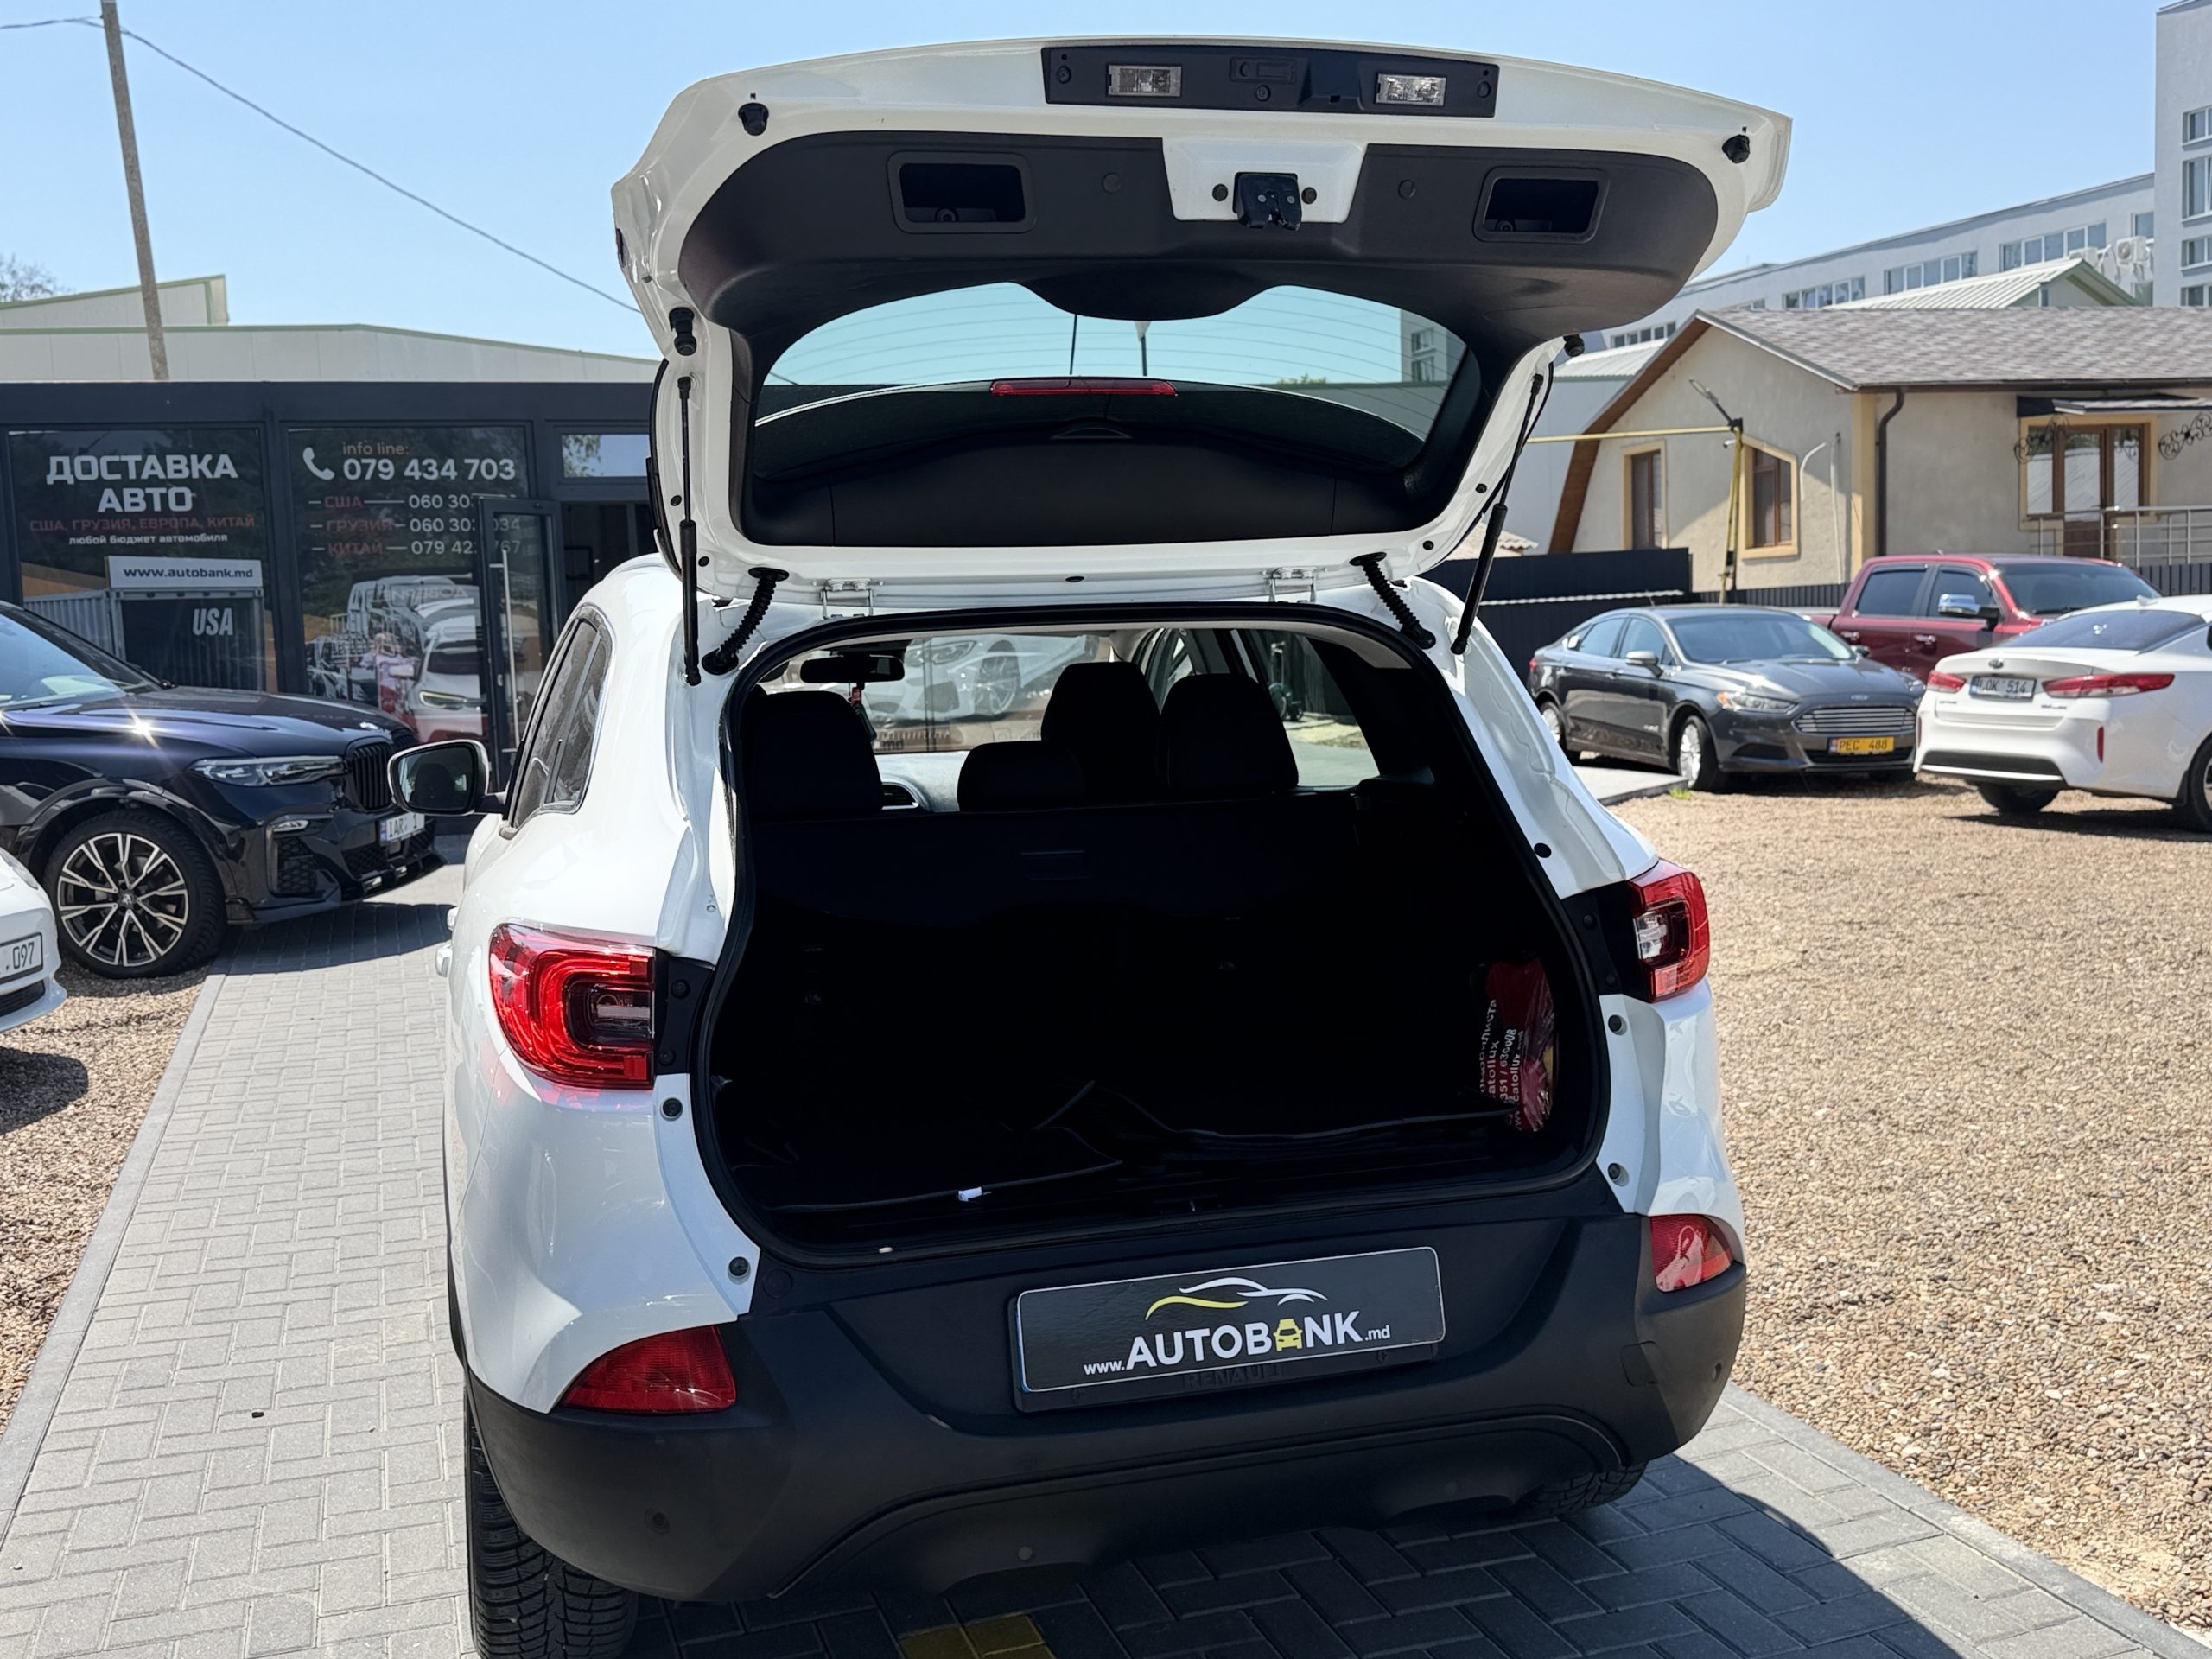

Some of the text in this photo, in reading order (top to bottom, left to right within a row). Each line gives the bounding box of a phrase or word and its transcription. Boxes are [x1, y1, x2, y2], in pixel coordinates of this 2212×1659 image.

[342, 442, 373, 455] info
[46, 454, 238, 485] ДОСТАВКА
[343, 458, 516, 480] 079 434 703
[97, 486, 194, 513] АВТО
[324, 496, 363, 509] США
[409, 494, 443, 509] 060
[207, 514, 255, 528] КИТАЙ
[327, 518, 394, 531] ГРУЗИЯ
[410, 518, 444, 532] 060
[69, 532, 228, 546] любой бюджет автомобиля
[328, 540, 383, 554] КИТАЙ
[411, 540, 446, 555] 079
[123, 567, 254, 578] www.autobank.md
[192, 607, 234, 637] USA
[12, 941, 35, 970] 097
